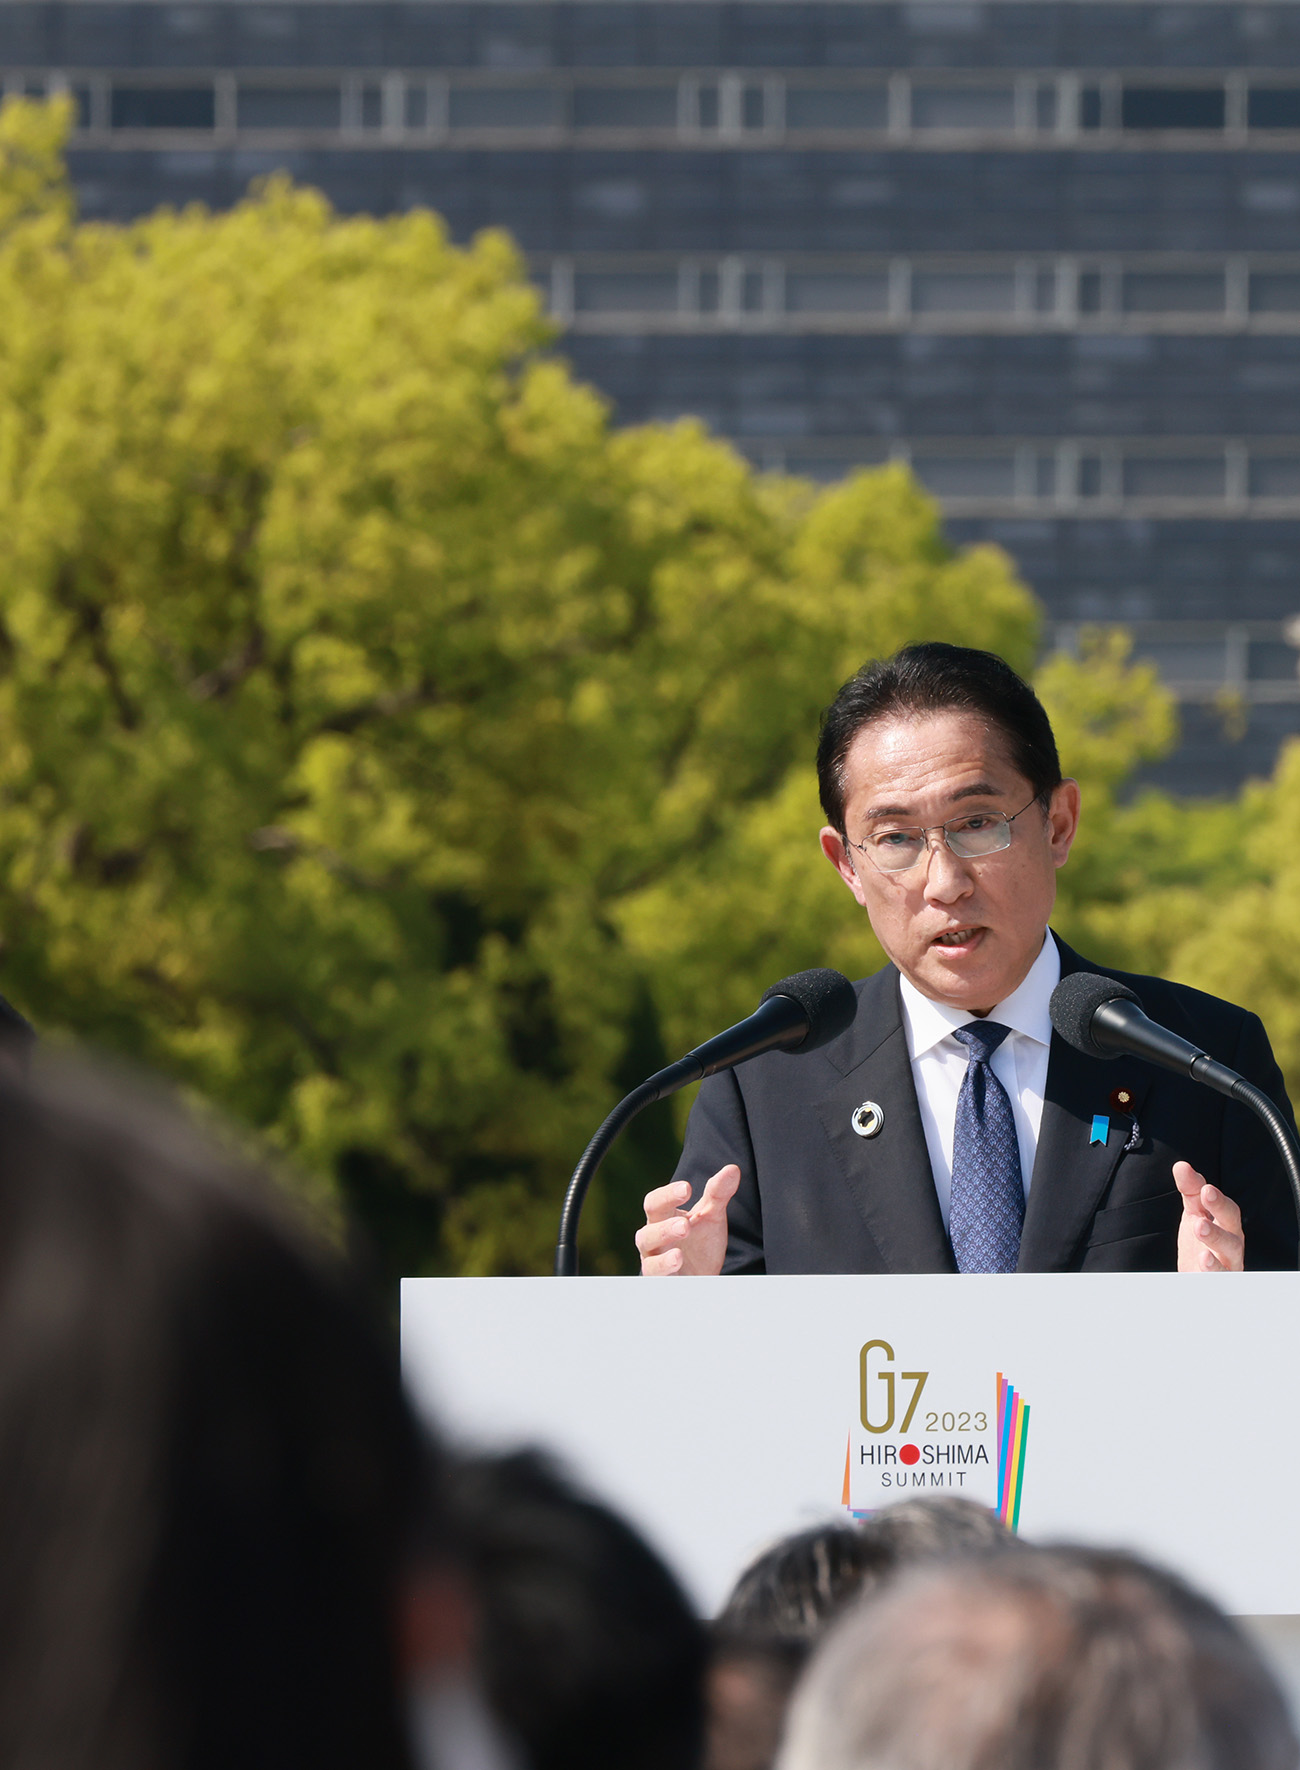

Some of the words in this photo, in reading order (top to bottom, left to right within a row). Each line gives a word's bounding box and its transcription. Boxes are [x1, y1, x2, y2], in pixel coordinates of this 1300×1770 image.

[859, 1339, 929, 1434] G7
[925, 1411, 988, 1432] 2023
[860, 1443, 989, 1466] HIROSHIMA
[881, 1472, 967, 1487] SUMMIT
